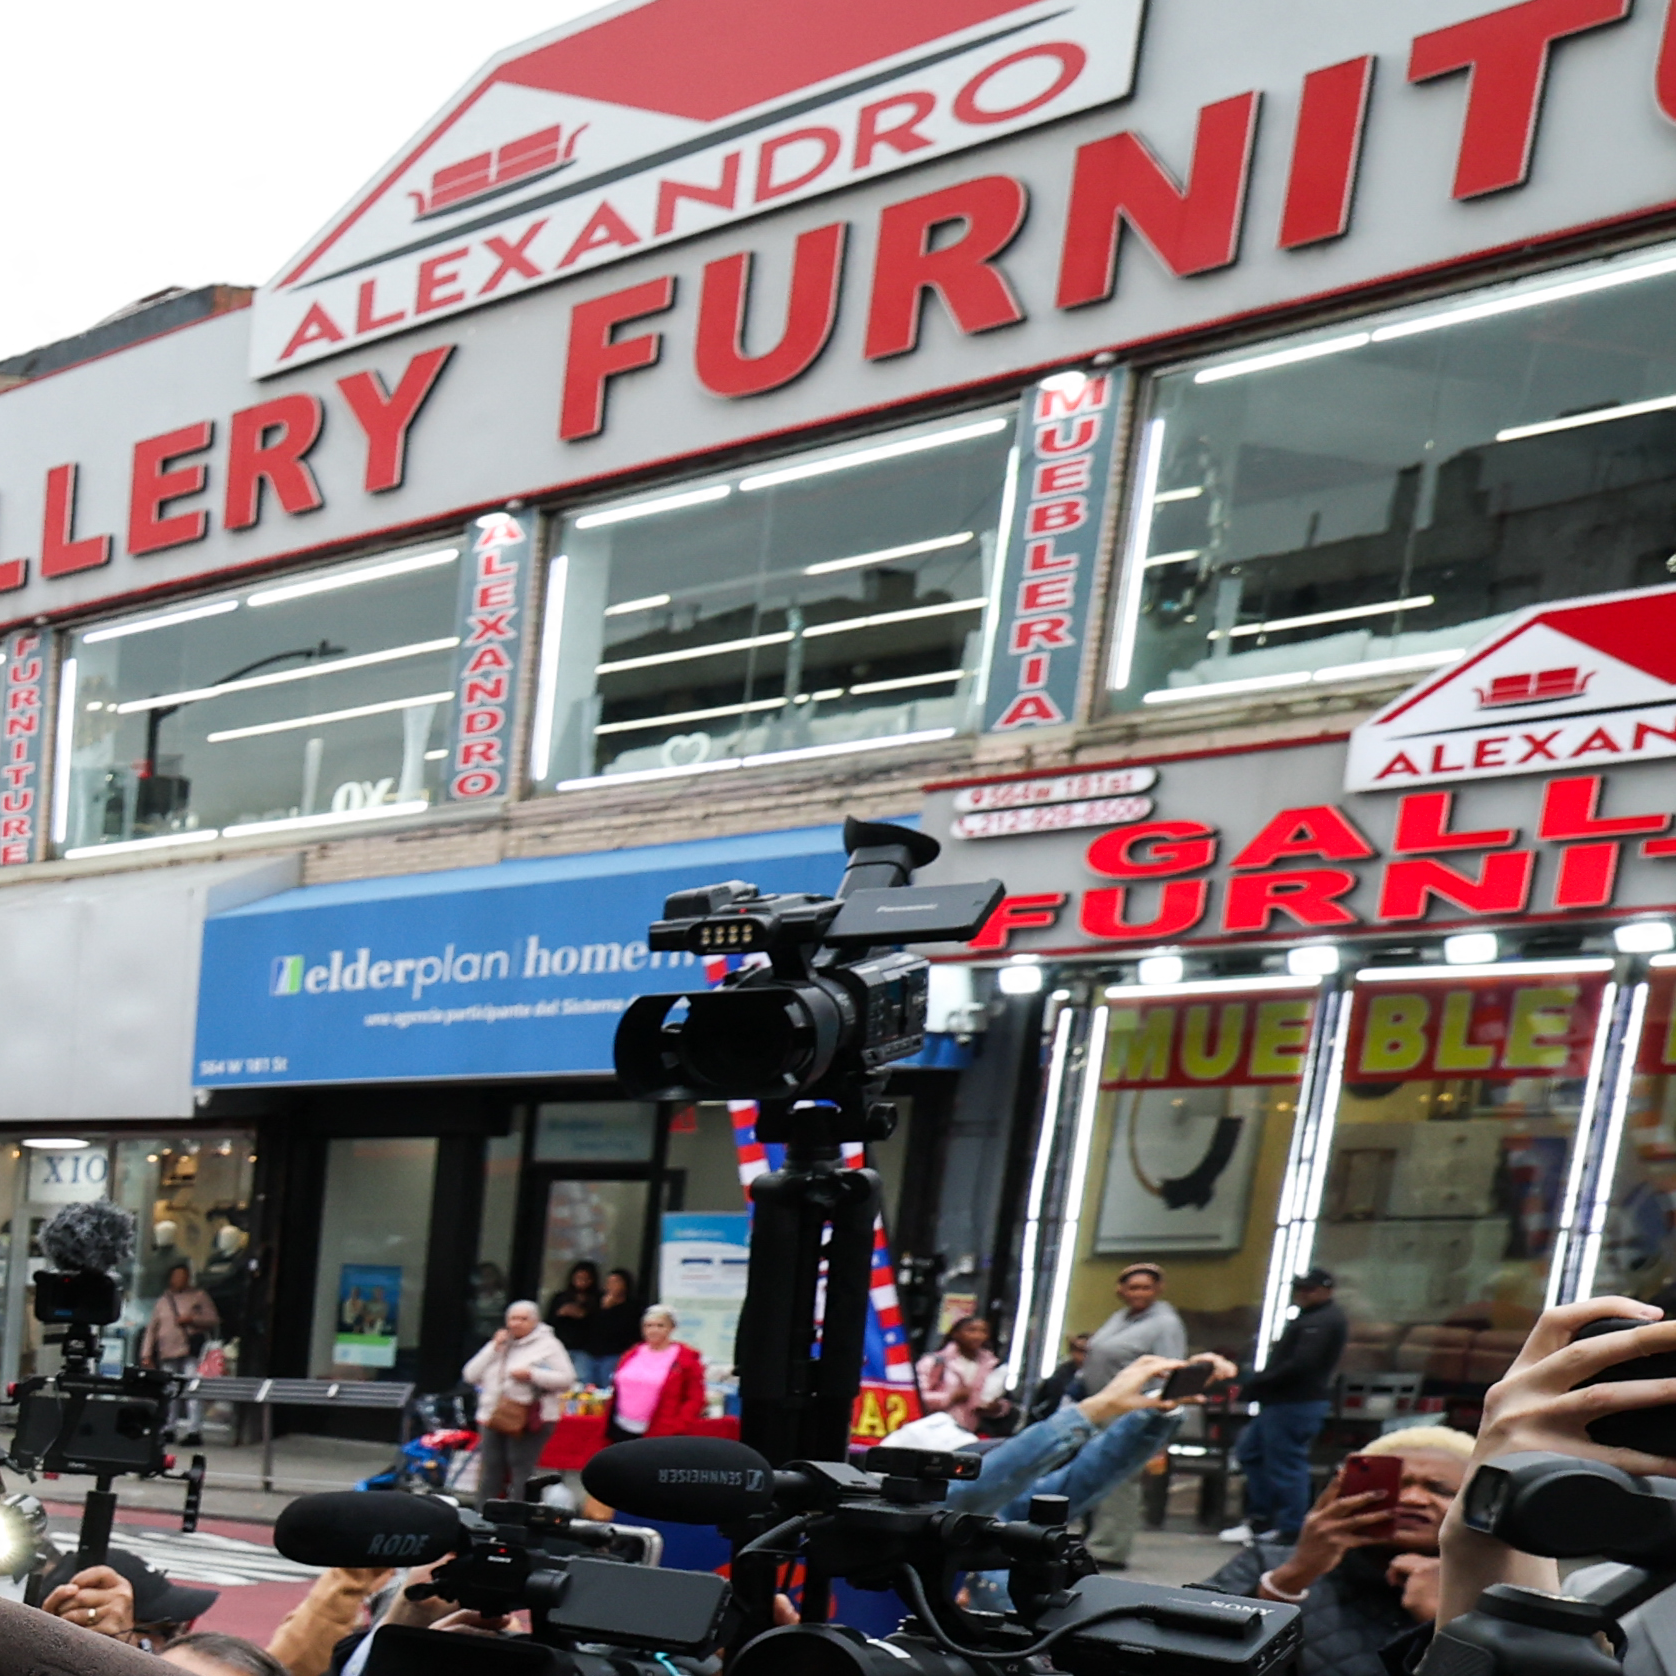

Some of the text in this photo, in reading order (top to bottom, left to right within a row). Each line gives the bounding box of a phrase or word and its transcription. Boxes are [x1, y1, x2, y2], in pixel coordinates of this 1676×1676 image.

[278, 41, 1087, 362] ALEXANDRO
[558, 0, 1676, 442] FURNIT
[449, 516, 526, 798] ALEXANDRO
[992, 374, 1110, 733] MUEBLERIA
[0, 636, 42, 866] FURNITURE
[304, 944, 510, 1000] elderplan
[967, 838, 1676, 950] FURNI
[658, 1466, 742, 1485] SENNHEISER
